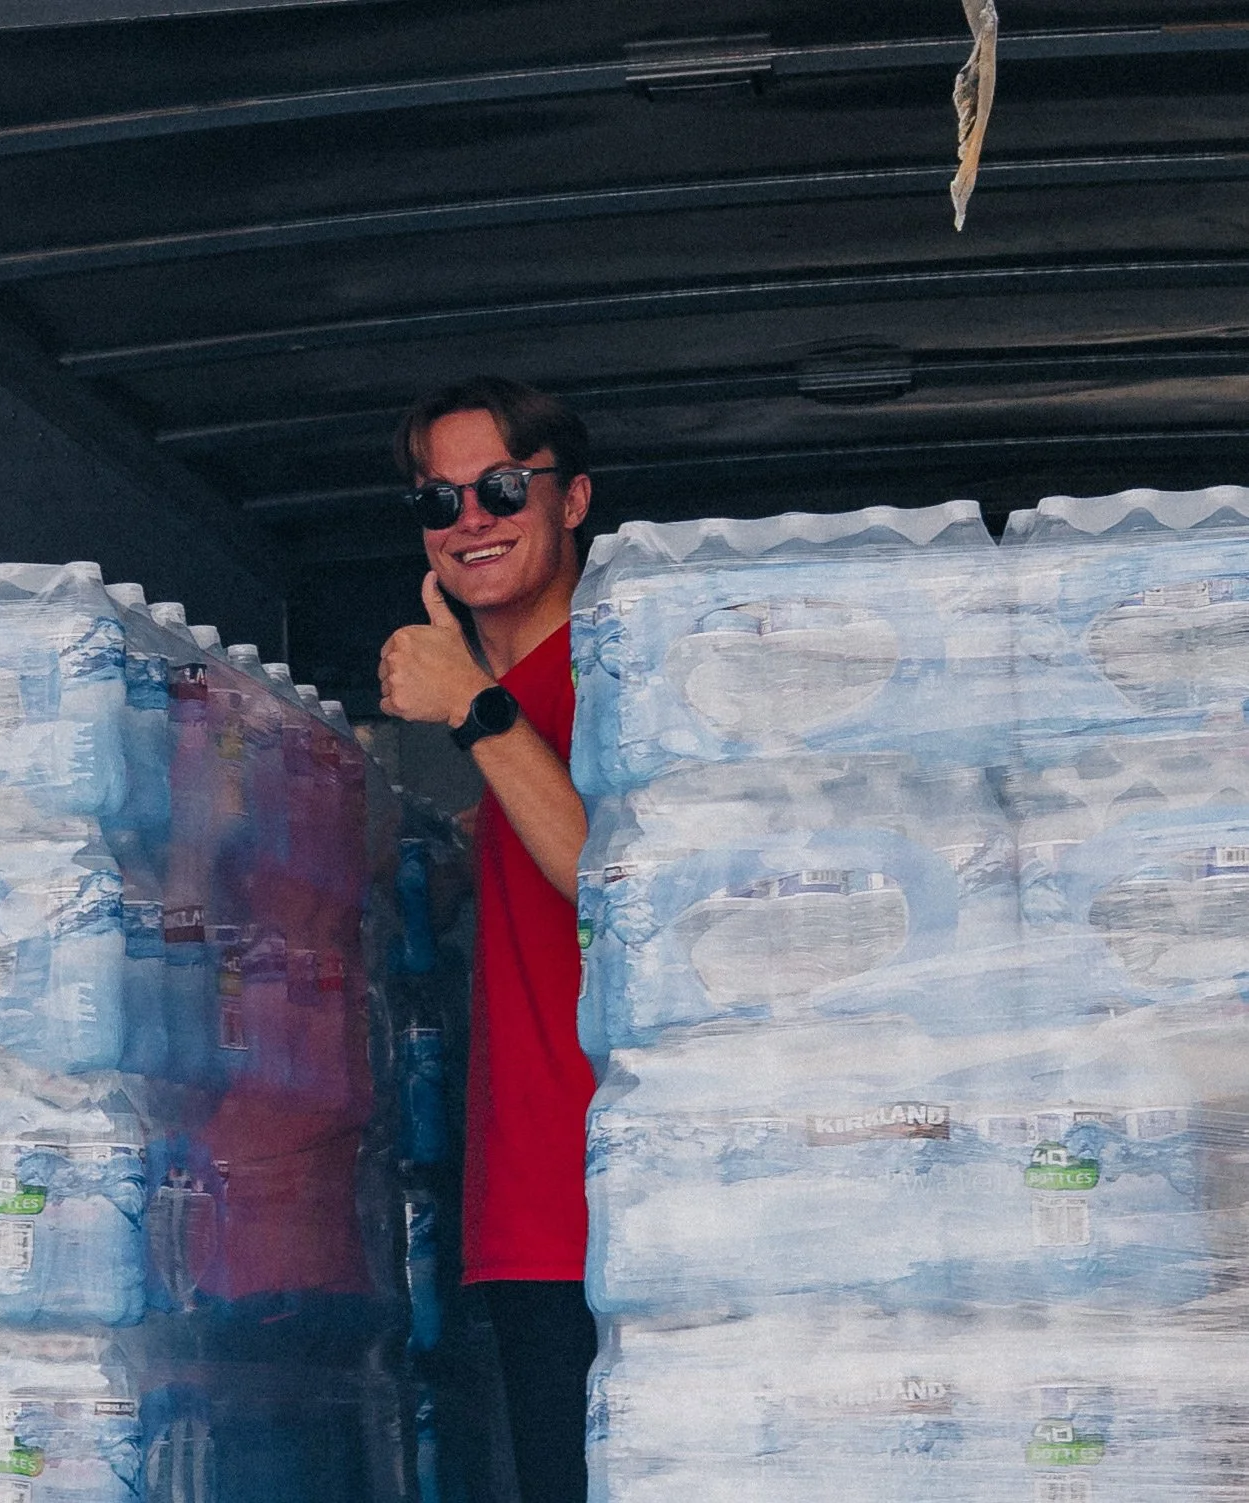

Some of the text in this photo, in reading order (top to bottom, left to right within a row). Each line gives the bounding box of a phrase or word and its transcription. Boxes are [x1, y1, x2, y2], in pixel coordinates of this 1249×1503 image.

[813, 1104, 947, 1135] KIRKLAND
[1032, 1148, 1068, 1168] 40
[1028, 1171, 1093, 1185] BOTTLES
[1032, 1424, 1074, 1442] 40
